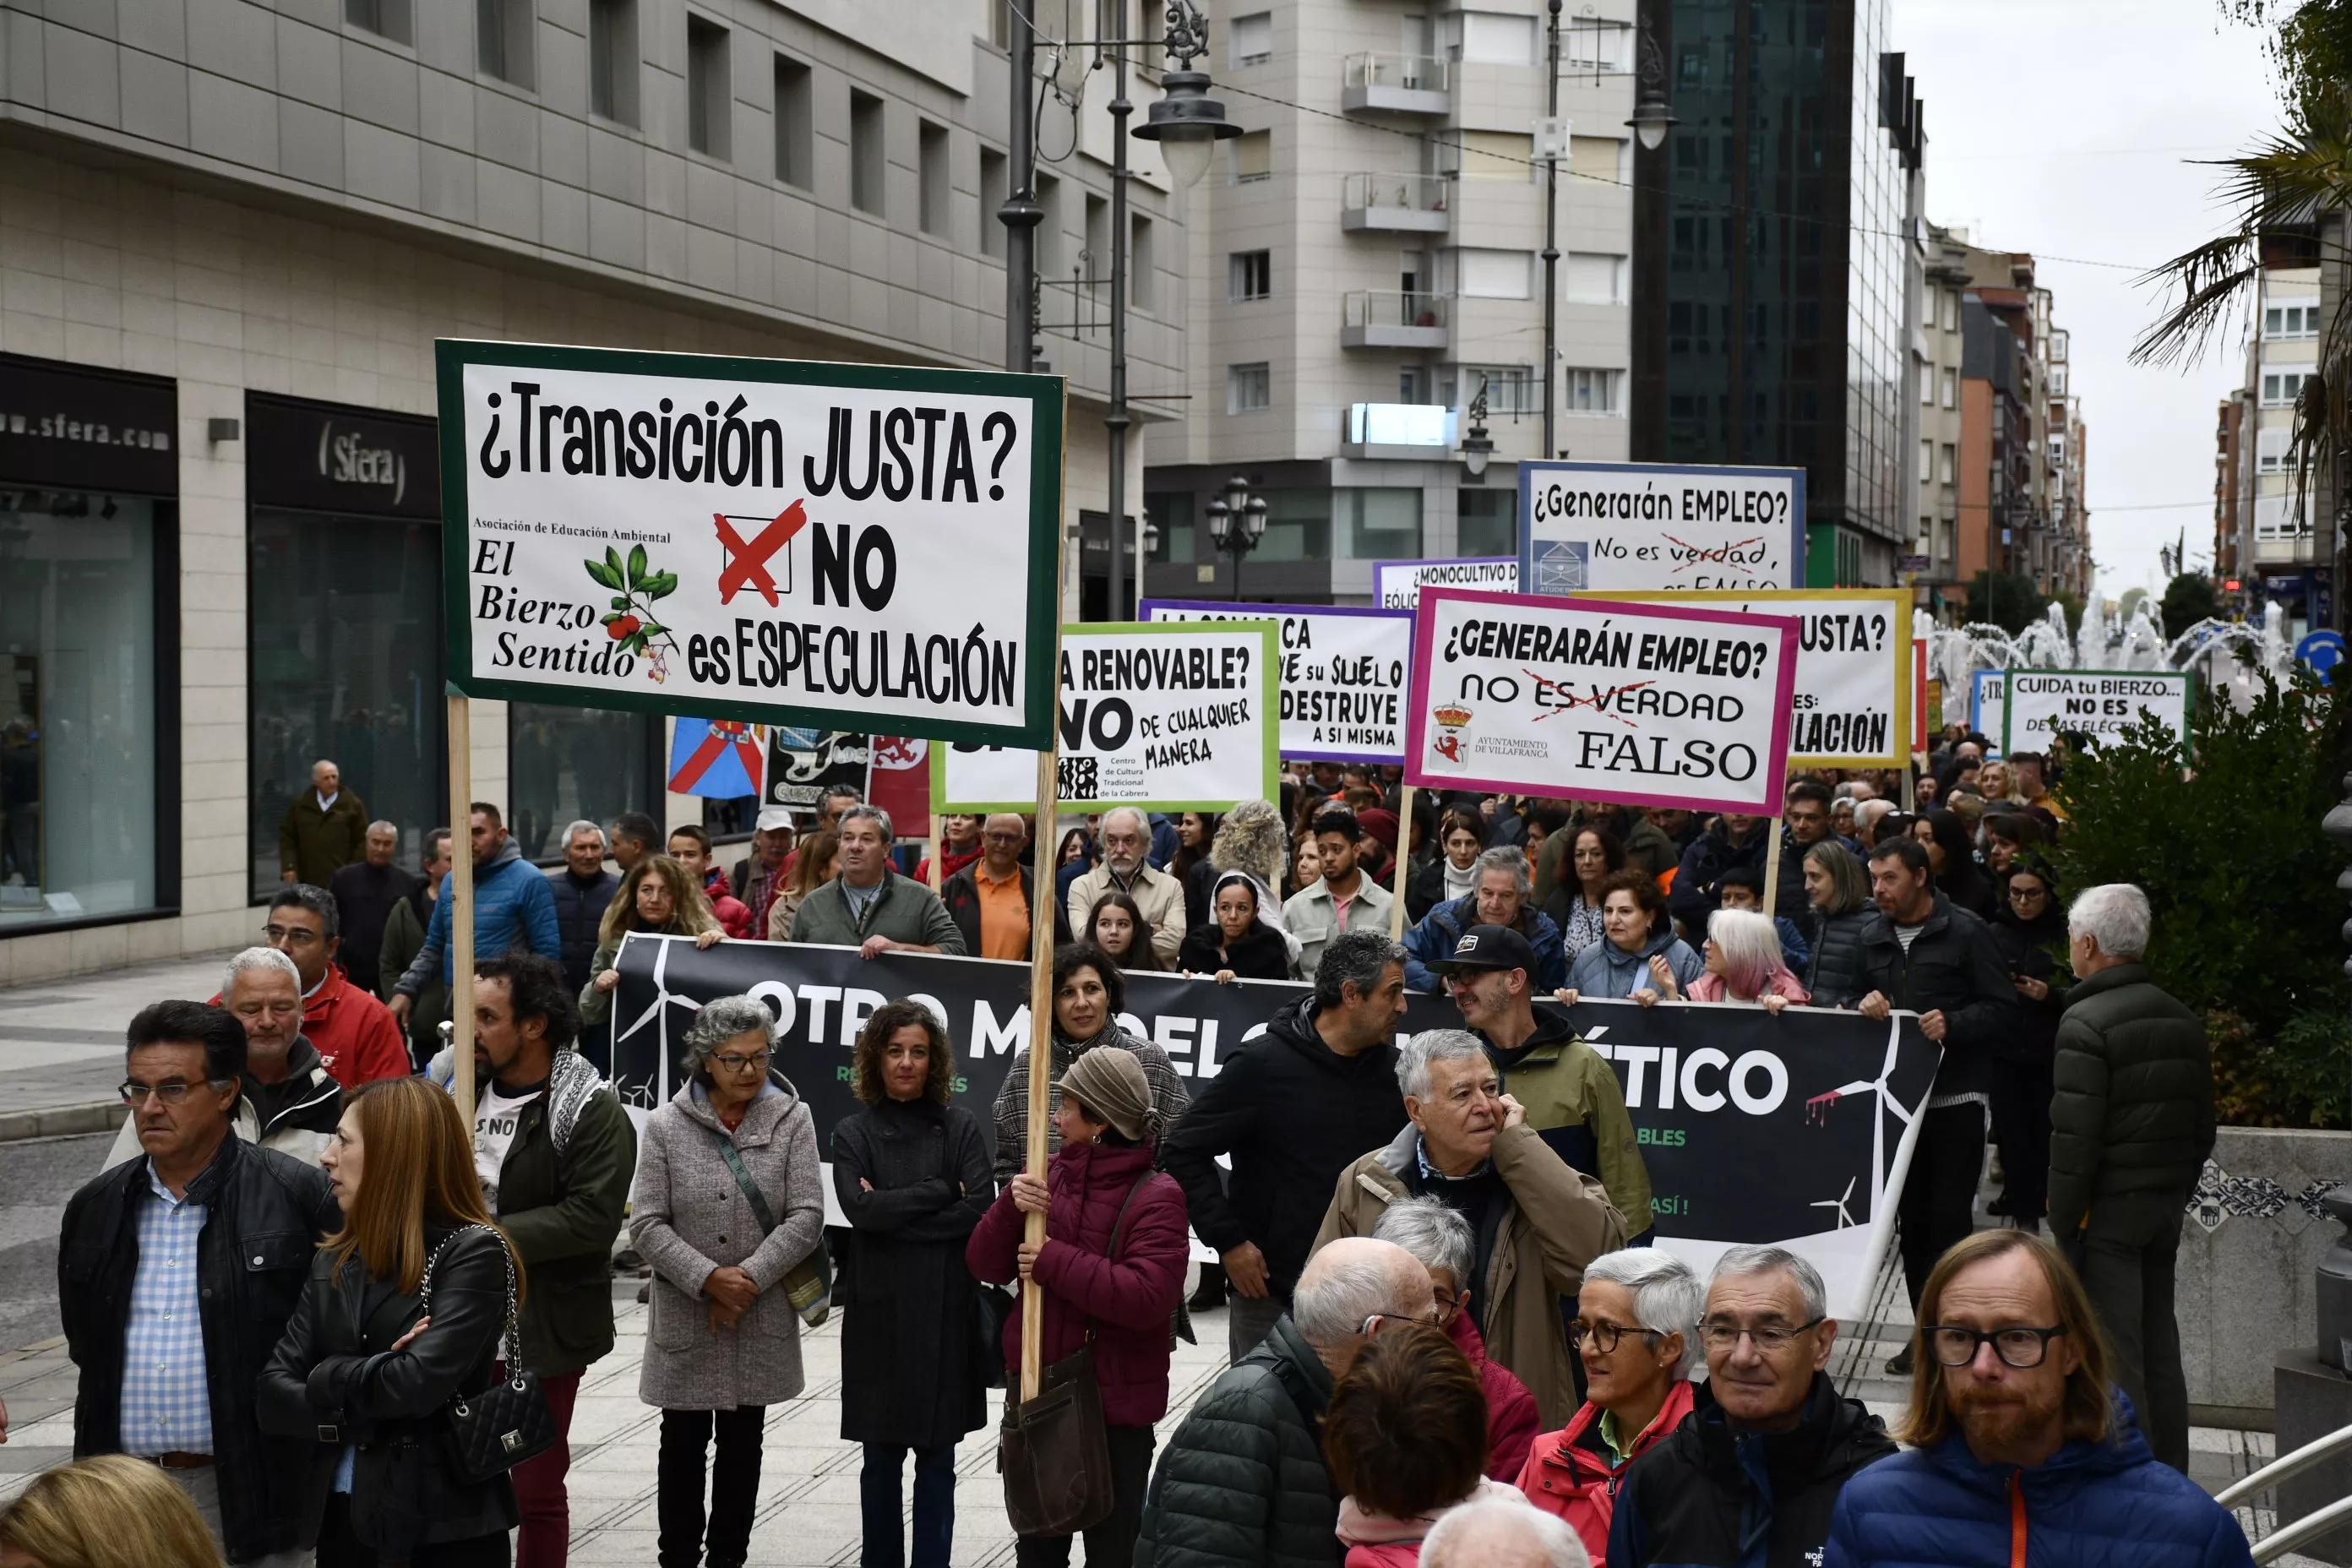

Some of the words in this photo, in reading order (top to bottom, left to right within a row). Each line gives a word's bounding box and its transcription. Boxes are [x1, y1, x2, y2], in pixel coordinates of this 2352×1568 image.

[480, 382, 784, 489] ¿Transición
[803, 406, 1018, 504] JUSTA?
[1534, 481, 1673, 523] ¿Generarán
[1682, 488, 1788, 525] EMPLEO?
[473, 517, 531, 532] Asociación
[535, 521, 548, 533] de
[551, 522, 609, 539] Educación
[611, 528, 672, 544] Ambiental
[1594, 536, 1629, 559] No
[1636, 546, 1660, 561] es
[471, 538, 516, 577] El
[812, 522, 897, 612] NO
[1413, 564, 1505, 589] ¿MONOCULTIVO
[475, 584, 596, 630] Bierzo
[1444, 619, 1632, 668] ¿GENERARÁN
[1637, 634, 1767, 679] EMPLEO?
[1798, 613, 1886, 652] USTA?
[492, 631, 635, 678] Sentido
[688, 632, 732, 687] es
[734, 618, 1018, 707] ESPECULACIÓN
[1082, 645, 1250, 692] RENOVABLE?
[1306, 663, 1324, 681] su
[1460, 673, 1519, 703] NO
[1534, 680, 1576, 708] ES
[1591, 683, 1744, 722] VERDAD
[2017, 678, 2073, 694] CUIDA
[2077, 681, 2097, 694] tu
[2100, 679, 2181, 698] BIERZO...
[1140, 715, 1161, 739] DE
[1167, 697, 1251, 734] CUALQUIER
[1280, 689, 1398, 725] DESTRUYE
[2066, 698, 2096, 715] NO
[2103, 699, 2129, 716] ES
[1145, 737, 1212, 770] MANERA
[1313, 727, 1323, 743] A
[1328, 727, 1342, 743] SI
[1348, 728, 1396, 746] MISMA
[1474, 744, 1487, 754] DE
[1489, 746, 1549, 759] VILLAFRANCA
[1477, 736, 1548, 750] AYUNTAMIENTO
[1574, 730, 1757, 781] FALSO
[1103, 778, 1144, 787] Tradicional
[488, 1118, 515, 1136] NO
